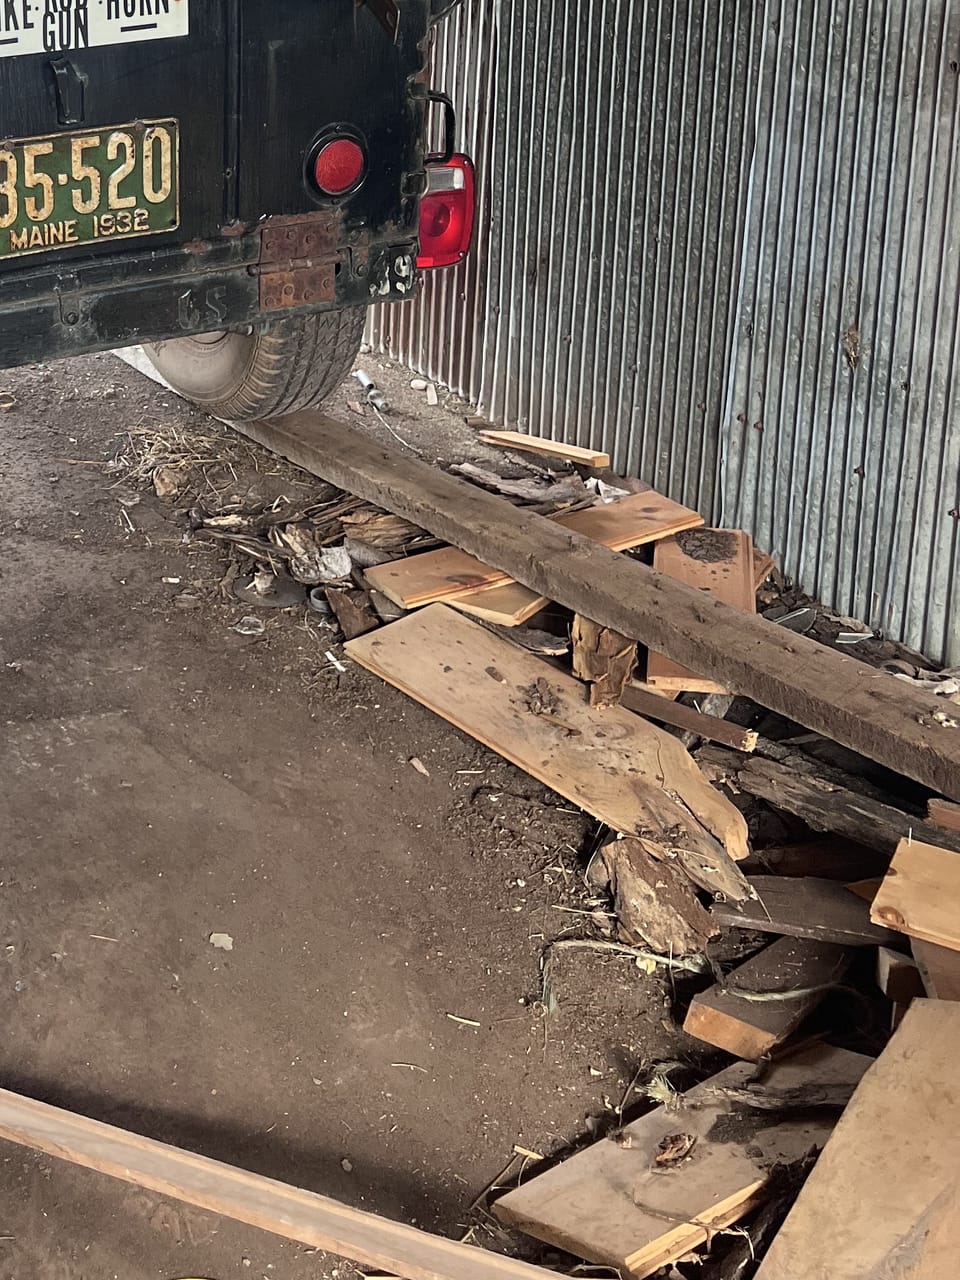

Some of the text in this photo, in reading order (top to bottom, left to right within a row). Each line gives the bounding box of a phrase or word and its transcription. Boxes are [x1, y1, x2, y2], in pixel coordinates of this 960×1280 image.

[43, 7, 88, 52] GUN
[10, 208, 151, 251] MAINE 1932
